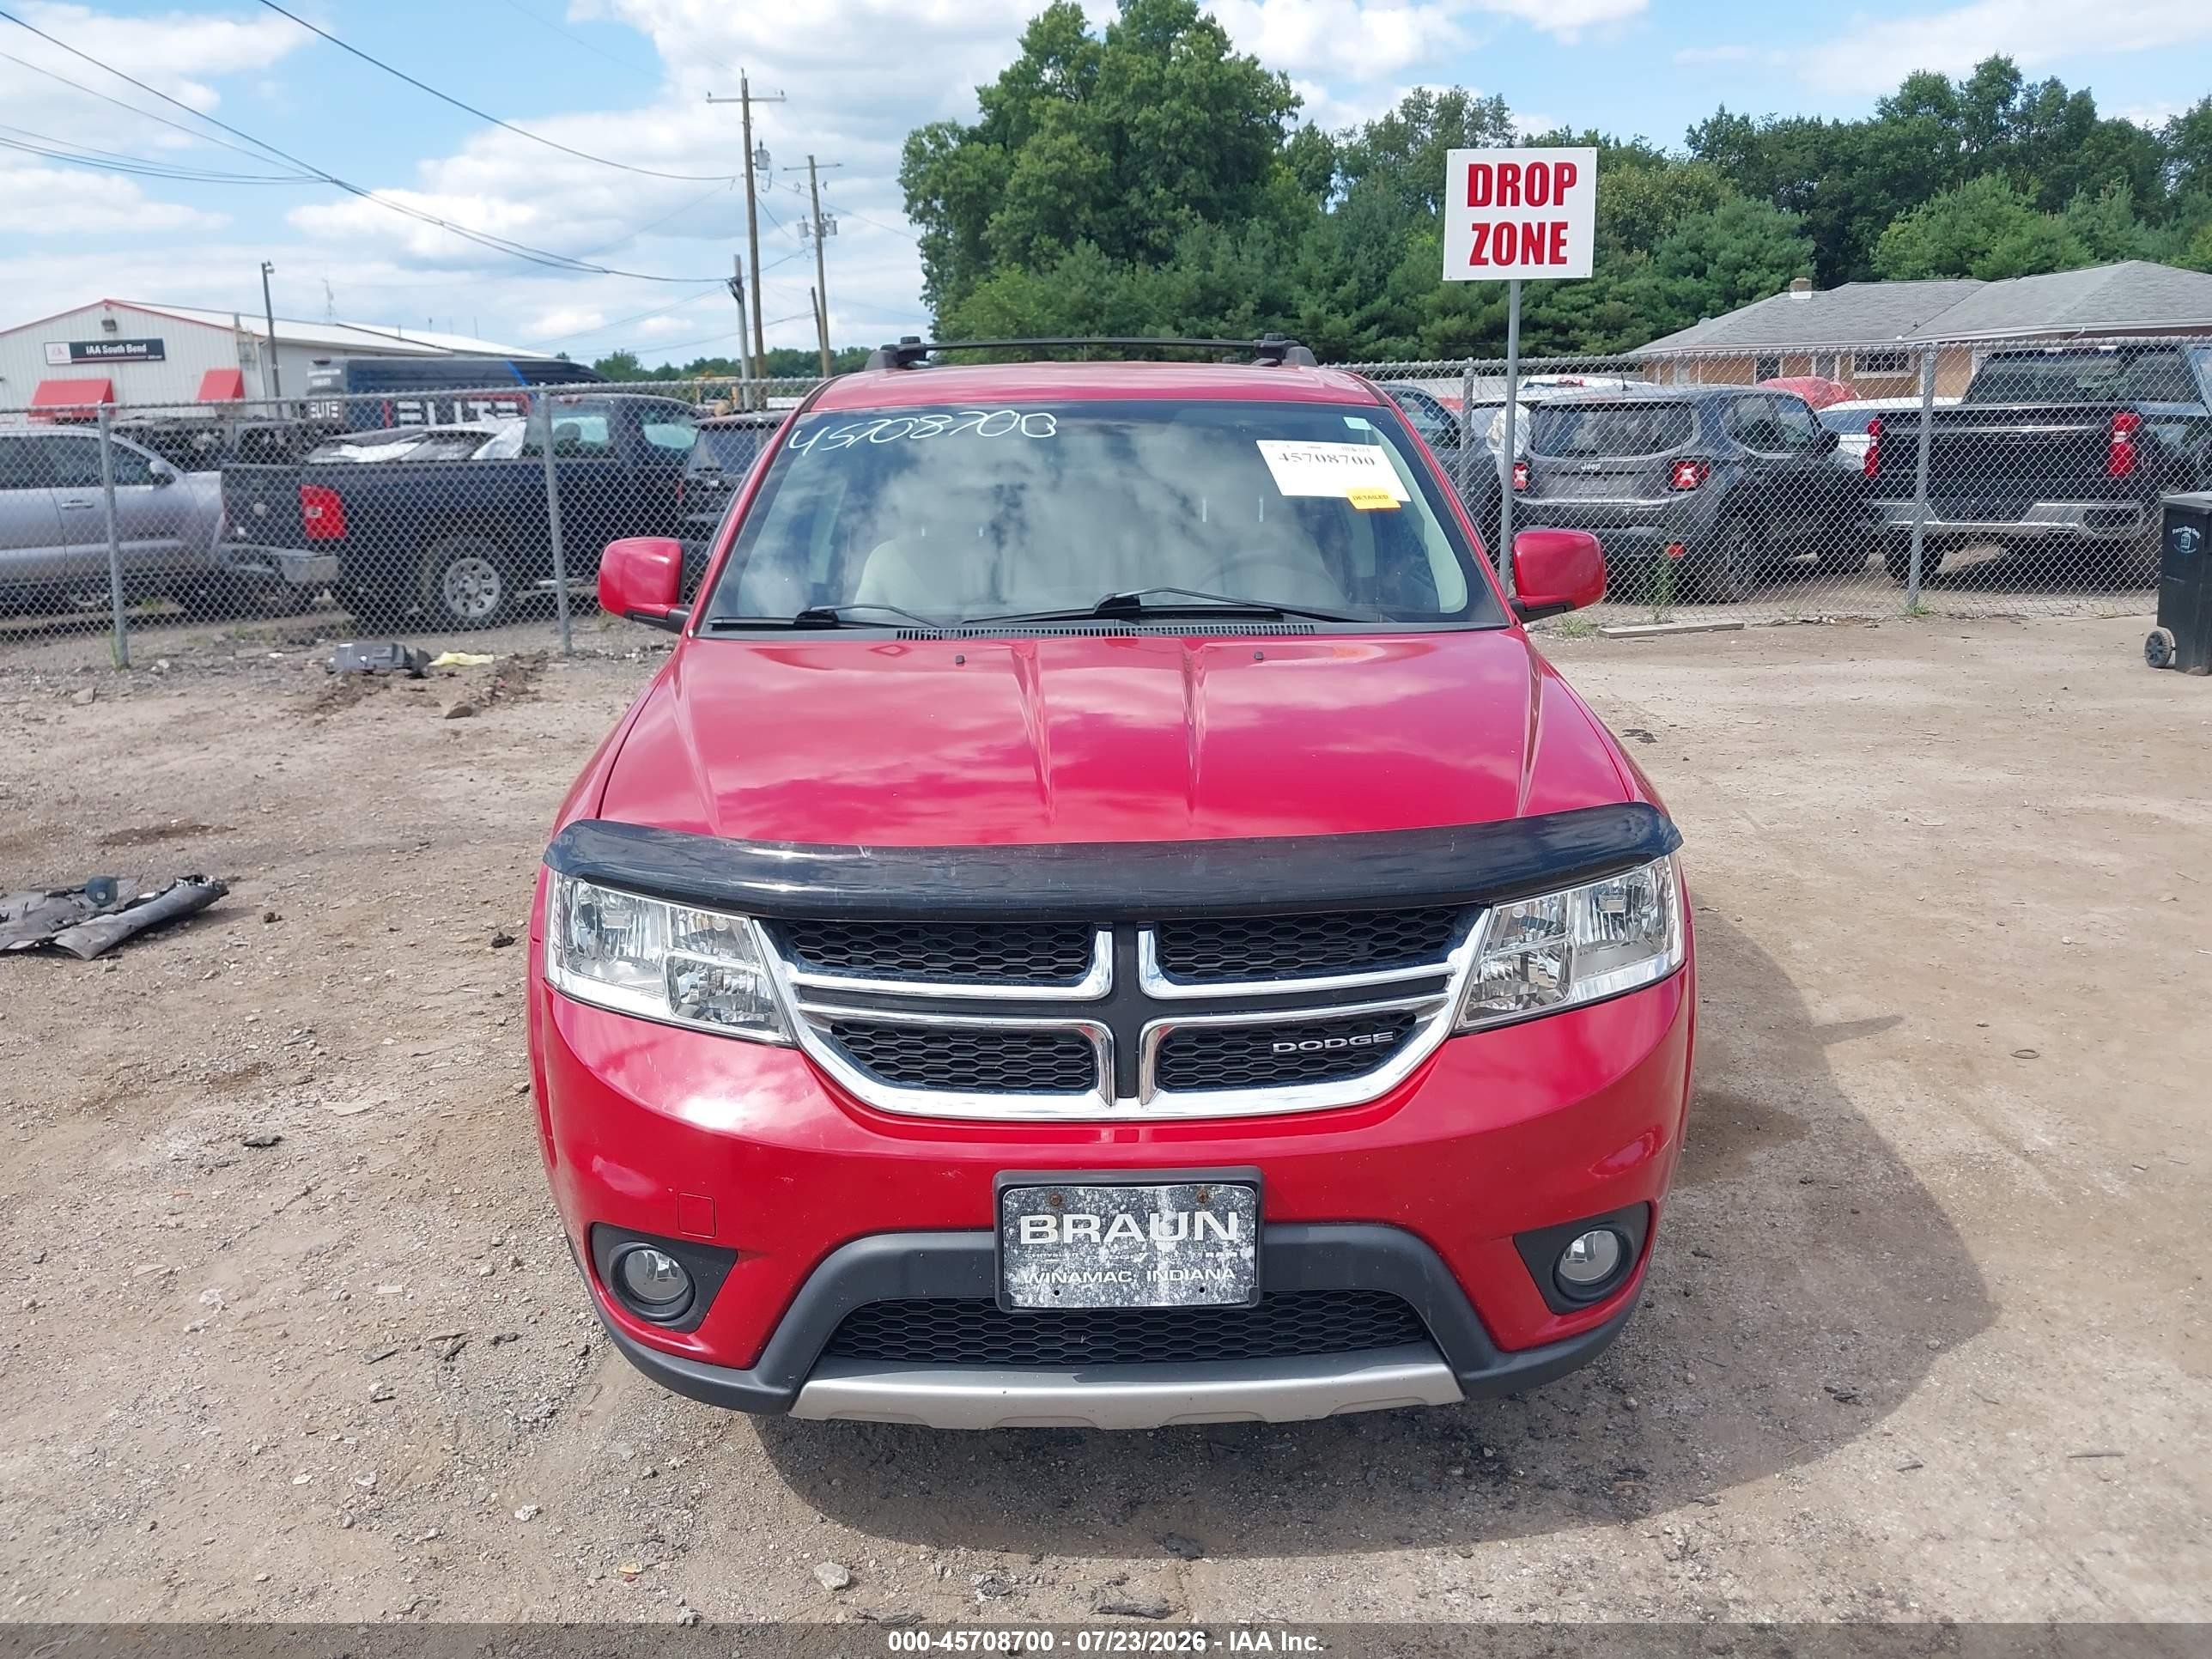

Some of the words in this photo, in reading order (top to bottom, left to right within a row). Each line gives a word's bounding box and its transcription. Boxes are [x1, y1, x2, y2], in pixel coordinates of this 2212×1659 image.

[1468, 161, 1577, 207] DROP
[1469, 222, 1569, 266] ZONE
[85, 345, 101, 355] IAA
[102, 344, 125, 354] South
[125, 343, 147, 353] Bend
[788, 410, 1057, 456] 45708700
[1279, 453, 1376, 465] 45708700
[1273, 1031, 1394, 1053] DODGE
[1020, 1211, 1237, 1244] BRAUN
[1146, 1268, 1236, 1282] INDIANA
